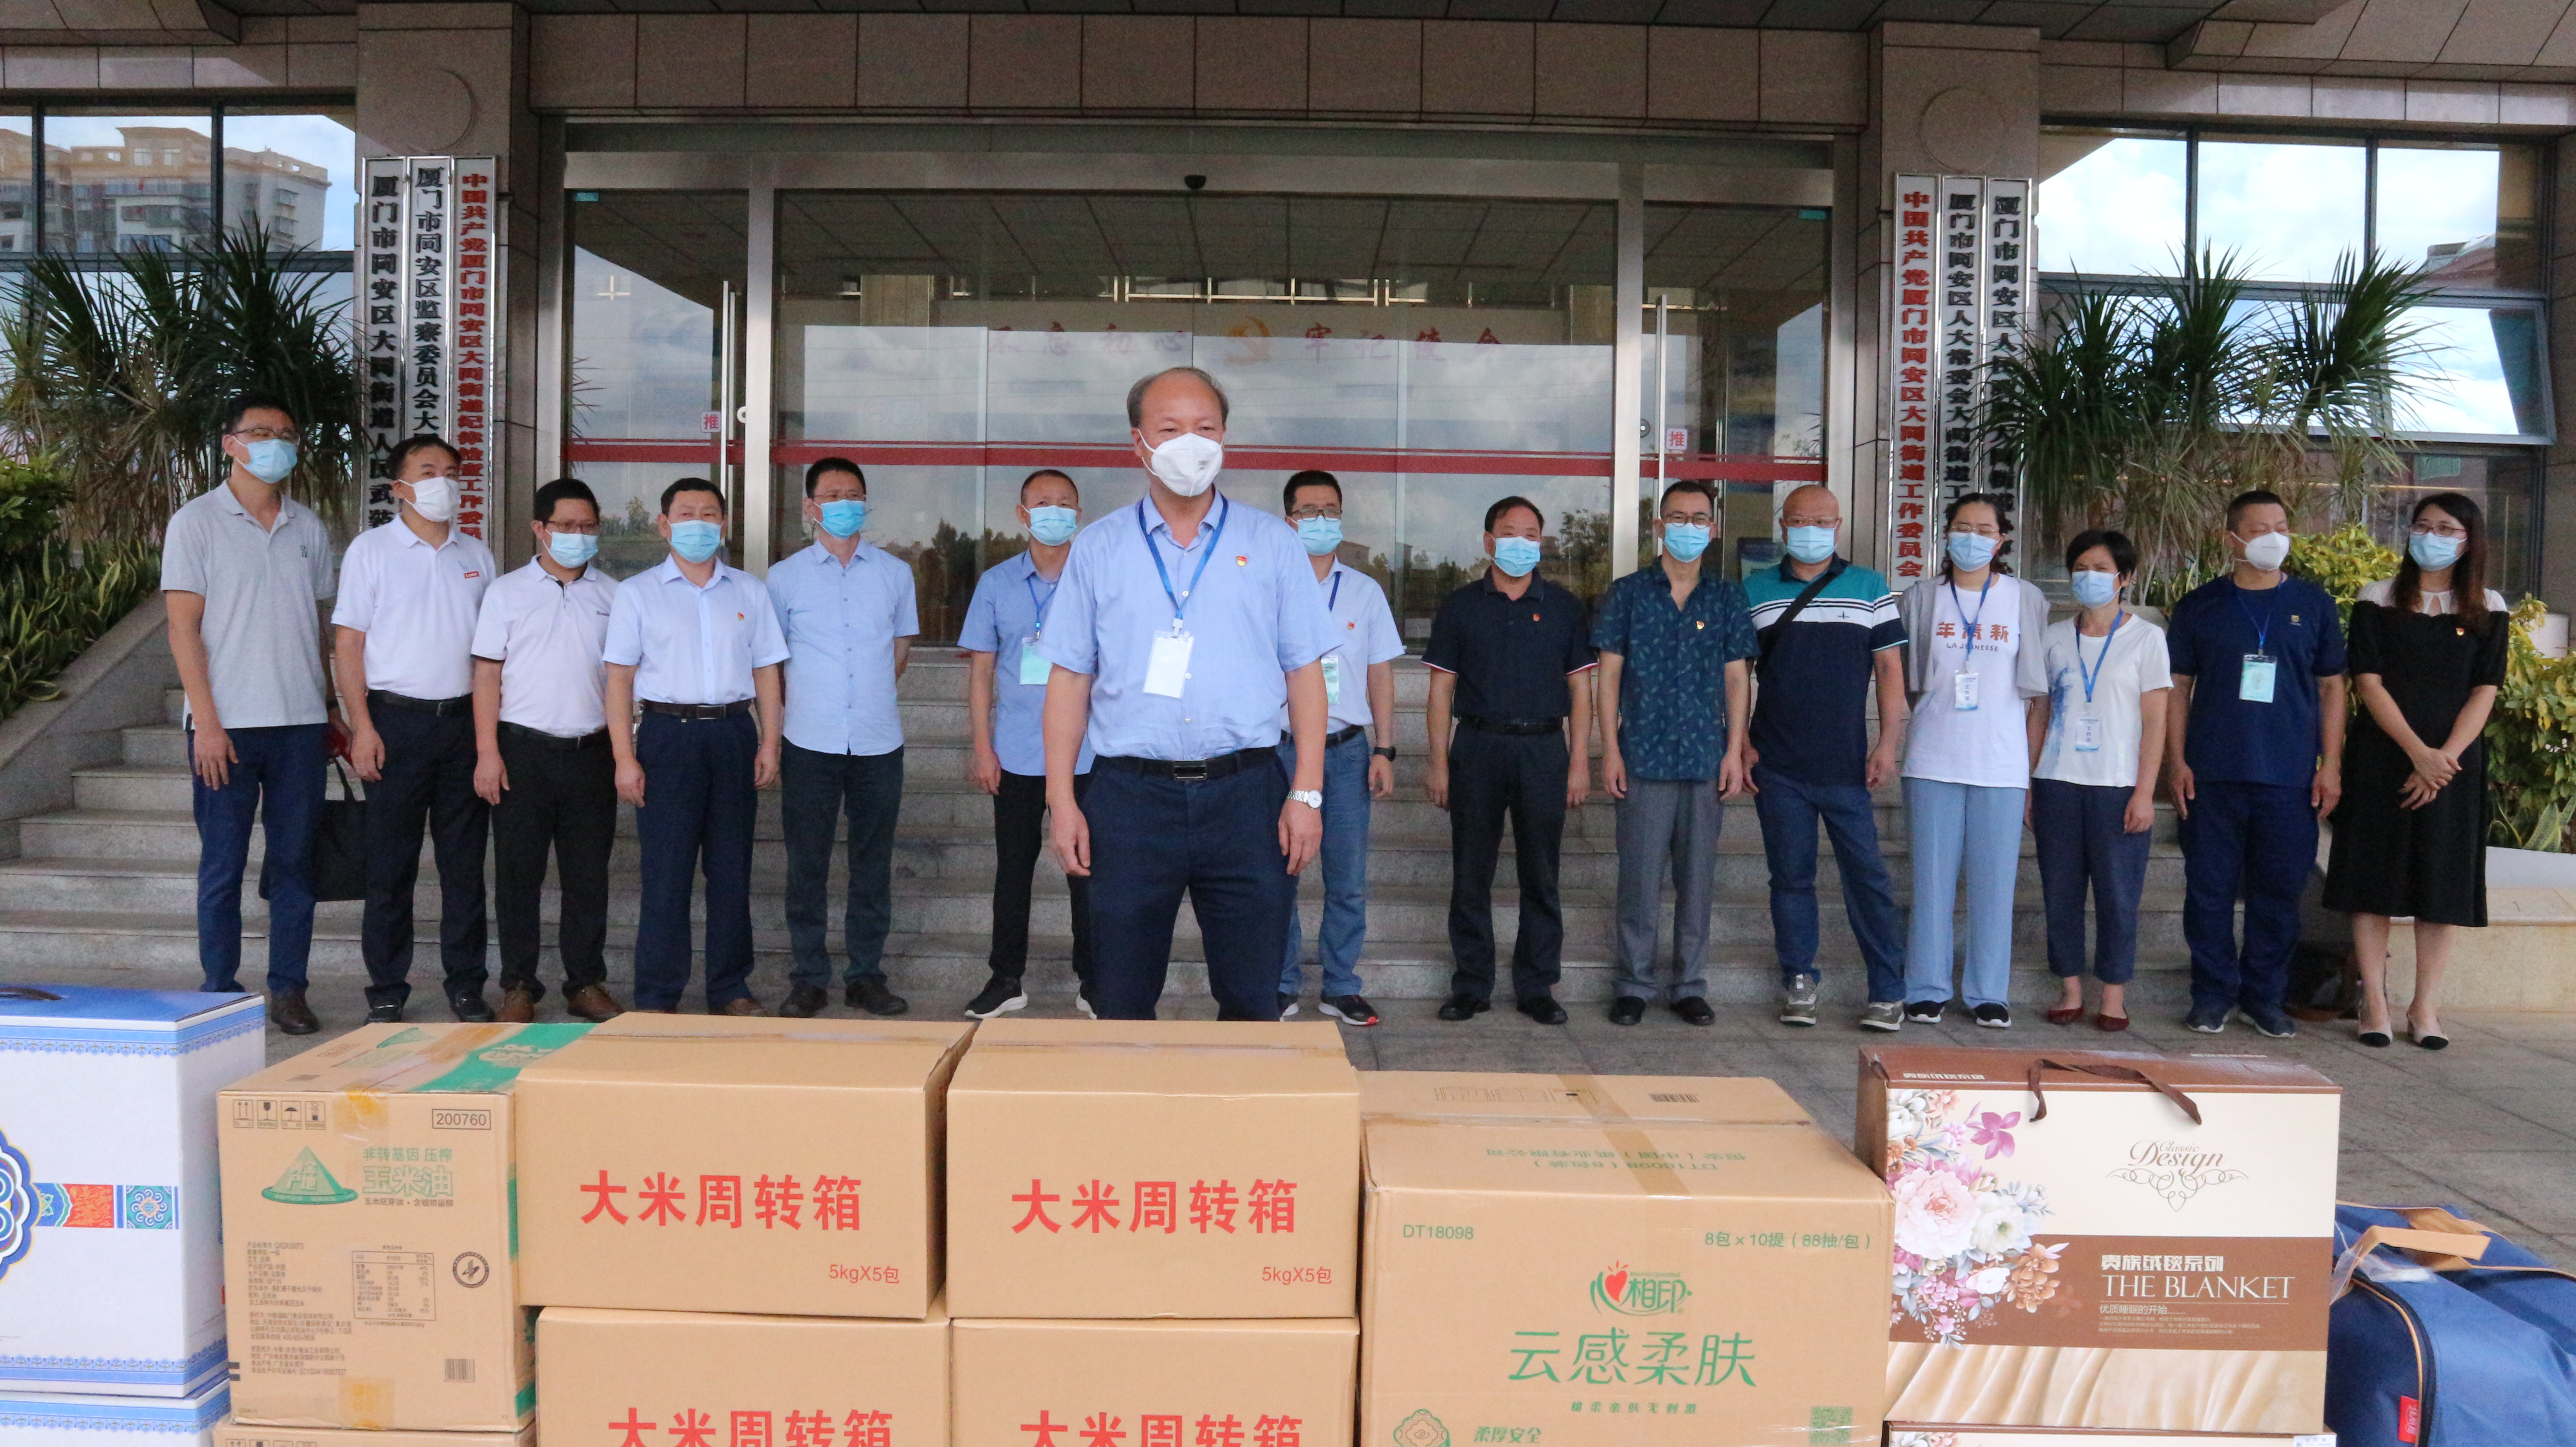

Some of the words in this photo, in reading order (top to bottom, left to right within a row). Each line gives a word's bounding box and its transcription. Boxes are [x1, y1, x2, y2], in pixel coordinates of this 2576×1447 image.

[413, 167, 444, 438] 厦门市同安区监察委员会大
[1943, 193, 1976, 507] 厦门市同安区人大常委会大同街道工
[1896, 191, 1931, 577] 中国共产党厦门市同安区大同街道工作委员会
[704, 413, 719, 430] 推
[1669, 430, 1685, 447] 推
[436, 1113, 487, 1126] 200760
[363, 1147, 419, 1162] 非转基因
[424, 1148, 453, 1162] 压榨
[2128, 1140, 2224, 1176] Design
[2159, 1141, 2199, 1152] Classic
[362, 1165, 454, 1197] 玉米油
[580, 1170, 862, 1231] 大米周转箱
[1011, 1179, 1298, 1234] 大米周转箱
[1402, 1224, 1474, 1240] DT18098
[828, 1264, 900, 1285] 5kgX5包
[1261, 1266, 1333, 1285] 5kgX5包
[2101, 1254, 2225, 1273] 贵族绒毯系列
[2102, 1275, 2157, 1298] THE
[2164, 1275, 2296, 1299] BLANKET
[1508, 1326, 1757, 1387] 云感柔肤
[609, 1407, 893, 1447] 大米周转箱
[1020, 1410, 1303, 1447] 大米周转箱
[1473, 1426, 1542, 1444] 柔厚安全
